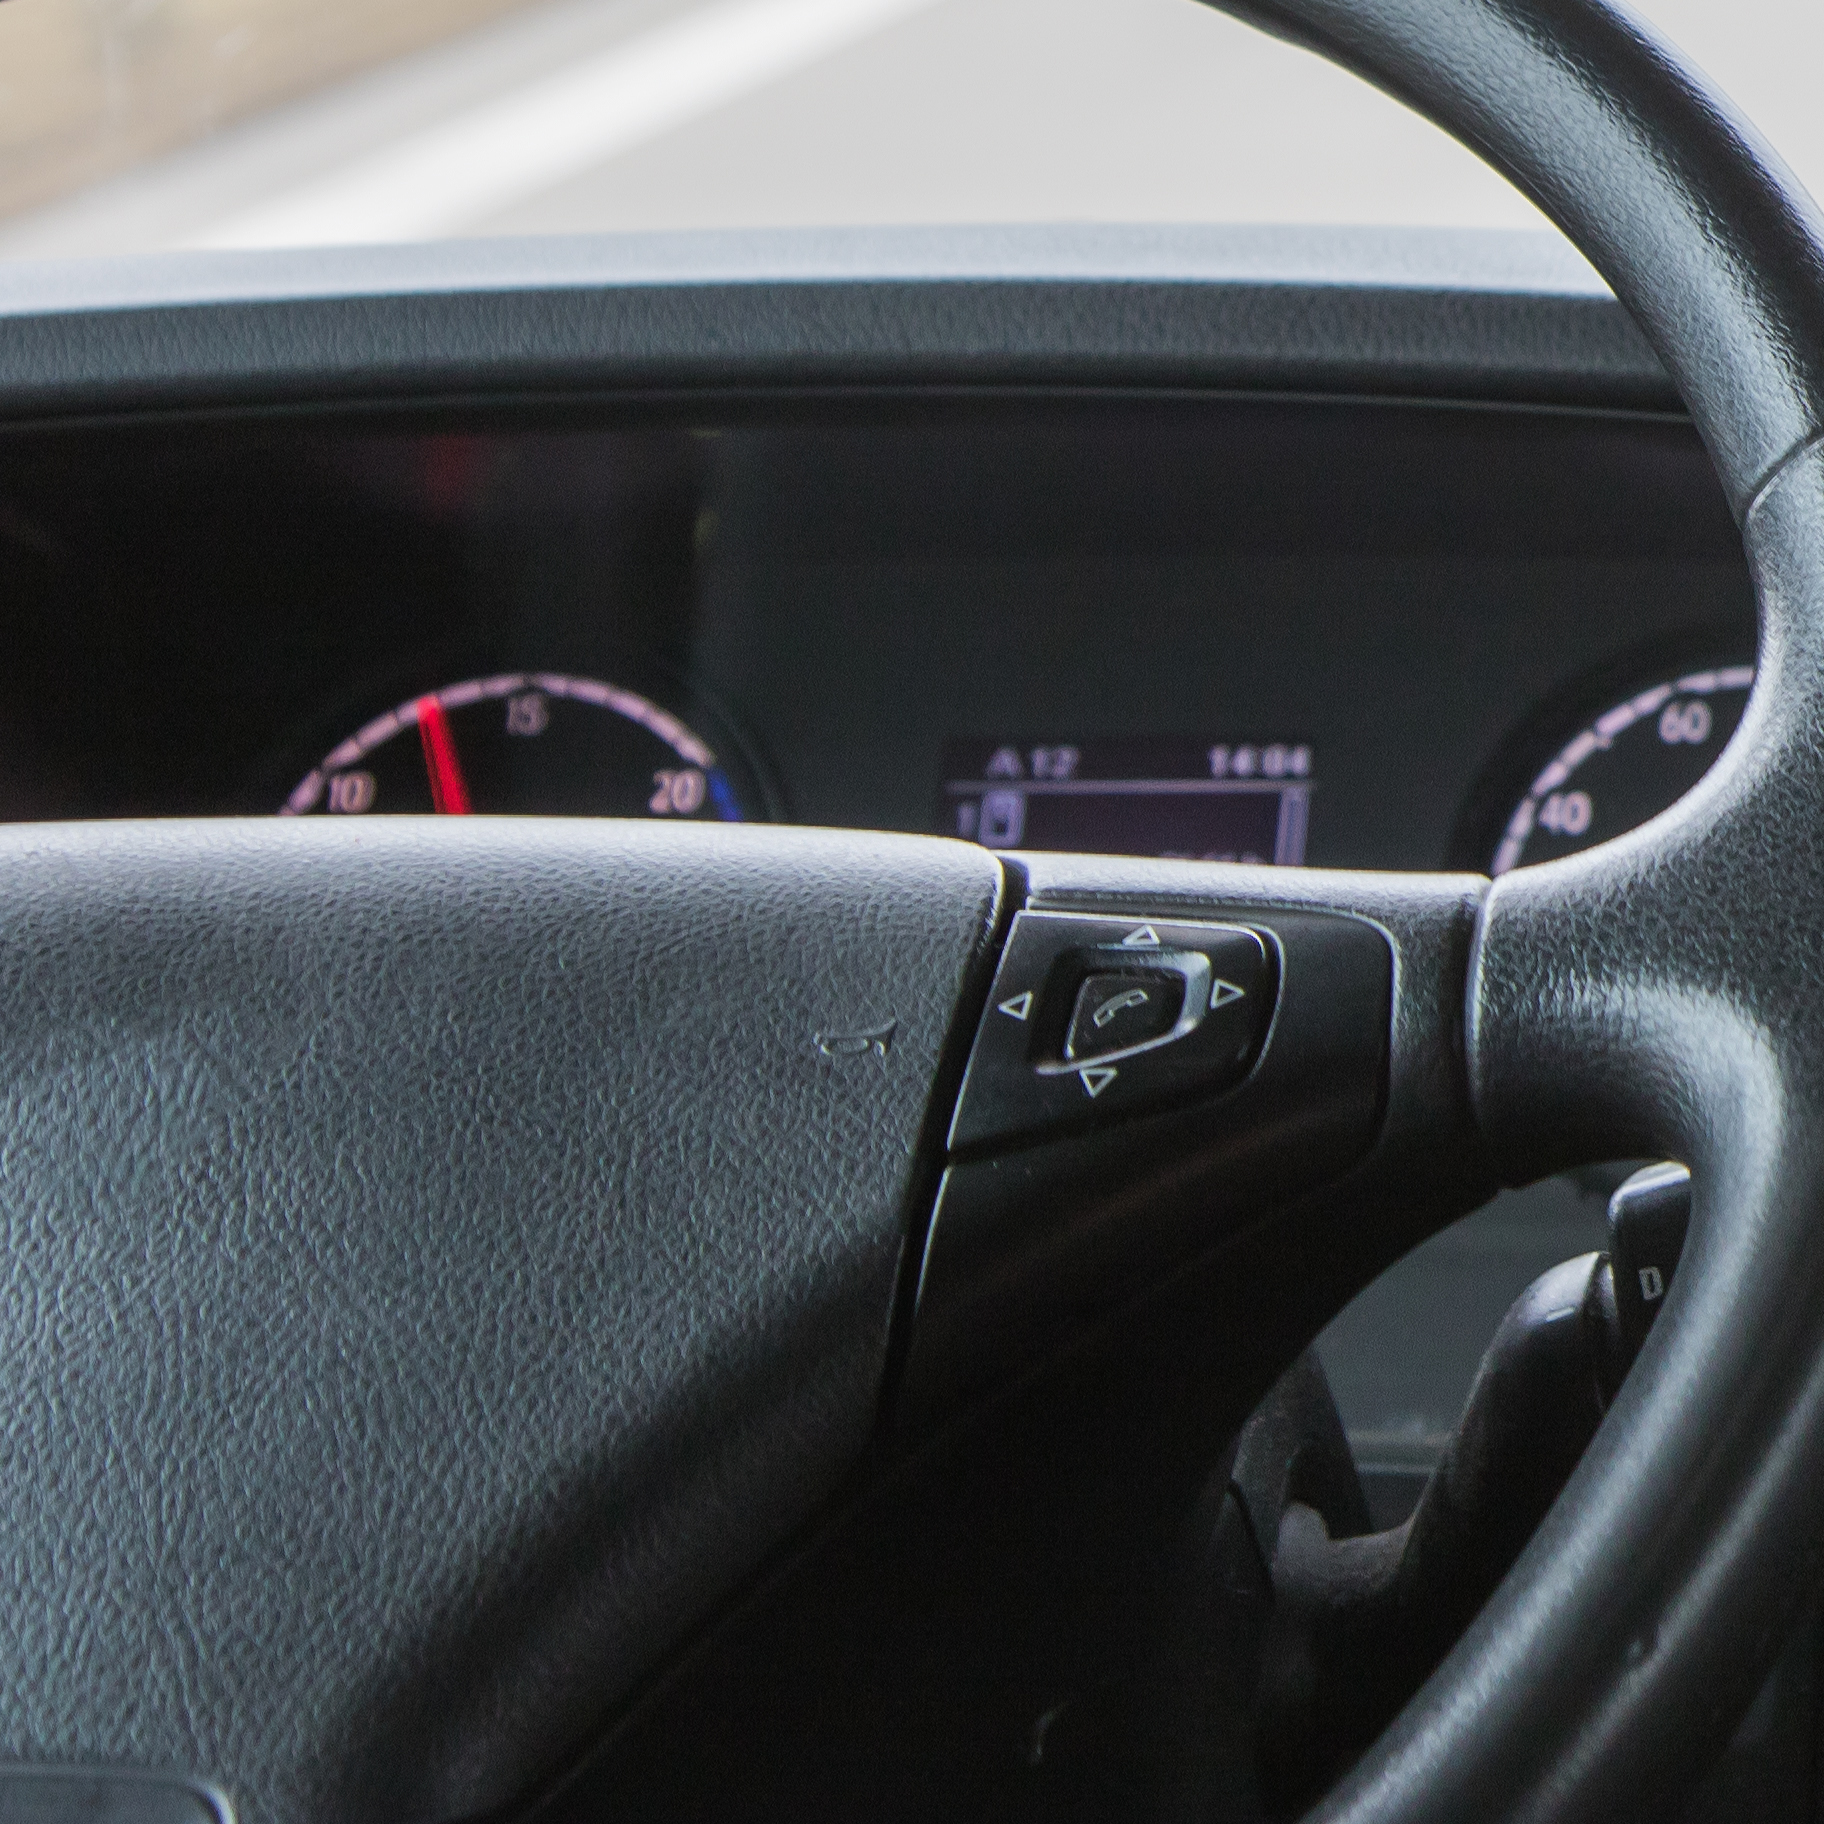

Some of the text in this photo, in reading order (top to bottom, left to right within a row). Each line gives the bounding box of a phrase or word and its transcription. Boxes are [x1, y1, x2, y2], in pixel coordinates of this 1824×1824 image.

[506, 695, 547, 735] 15
[1657, 701, 1711, 743] 60
[328, 773, 374, 812] 10
[649, 770, 706, 814] 20
[1538, 790, 1592, 834] 40
[1638, 1266, 1664, 1301] D
